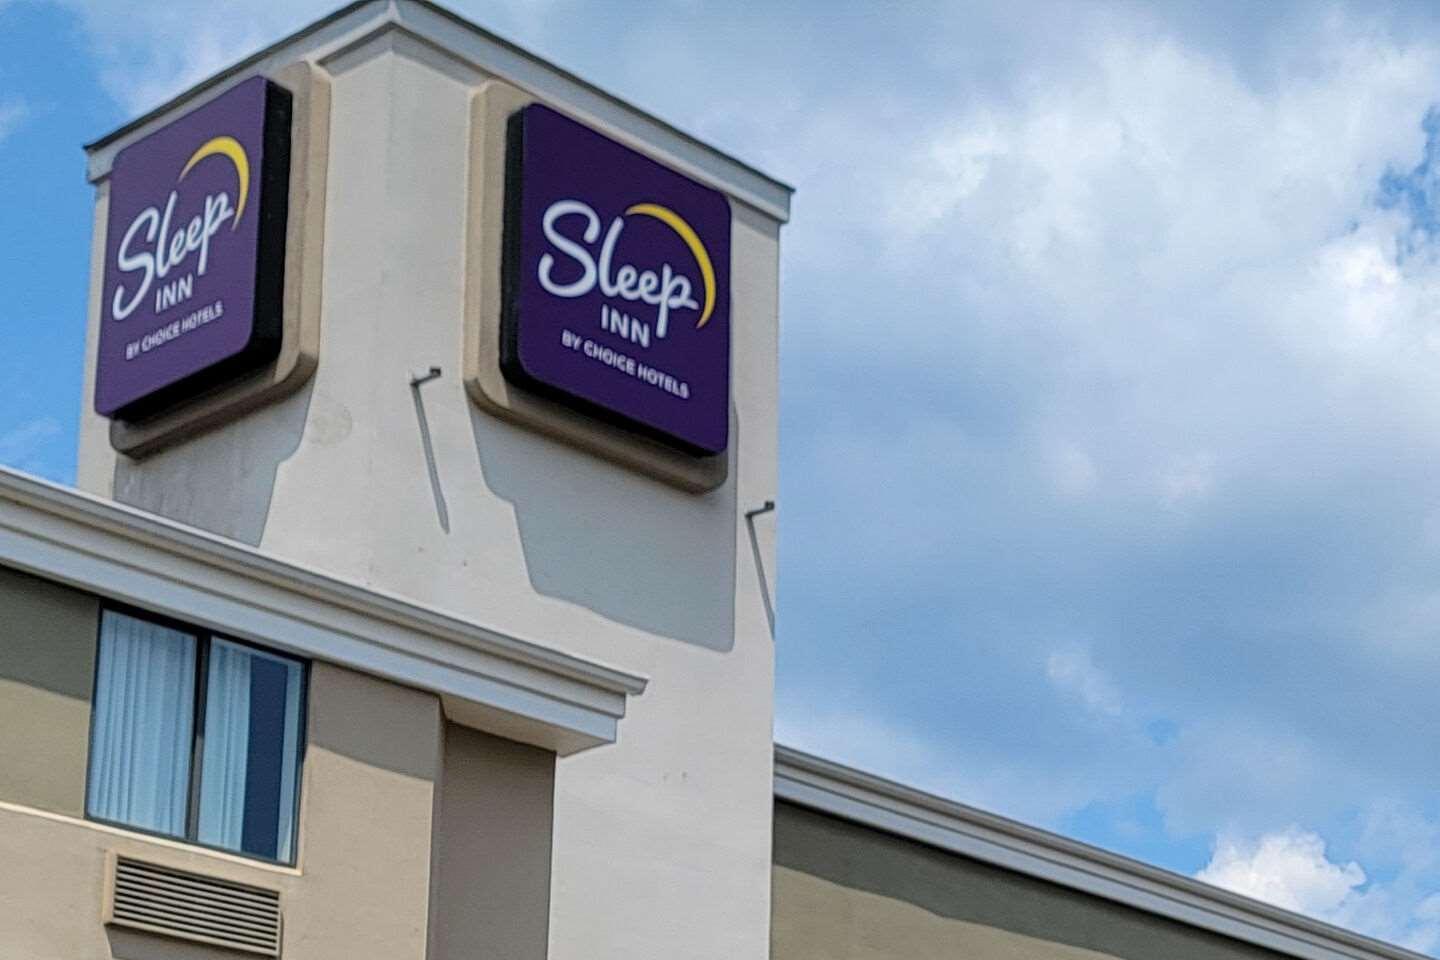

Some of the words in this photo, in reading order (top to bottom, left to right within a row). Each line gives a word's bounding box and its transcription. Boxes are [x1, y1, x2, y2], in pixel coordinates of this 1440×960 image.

[112, 190, 234, 321] Sleep
[538, 200, 699, 338] Sleep
[155, 273, 193, 314] INN
[601, 303, 650, 348] INN
[126, 340, 140, 360] BY
[142, 321, 180, 352] CHOICE
[182, 300, 223, 333] HOTELS
[562, 329, 582, 350] BY
[584, 340, 635, 376] CHOICE
[638, 363, 690, 399] HOTELS
